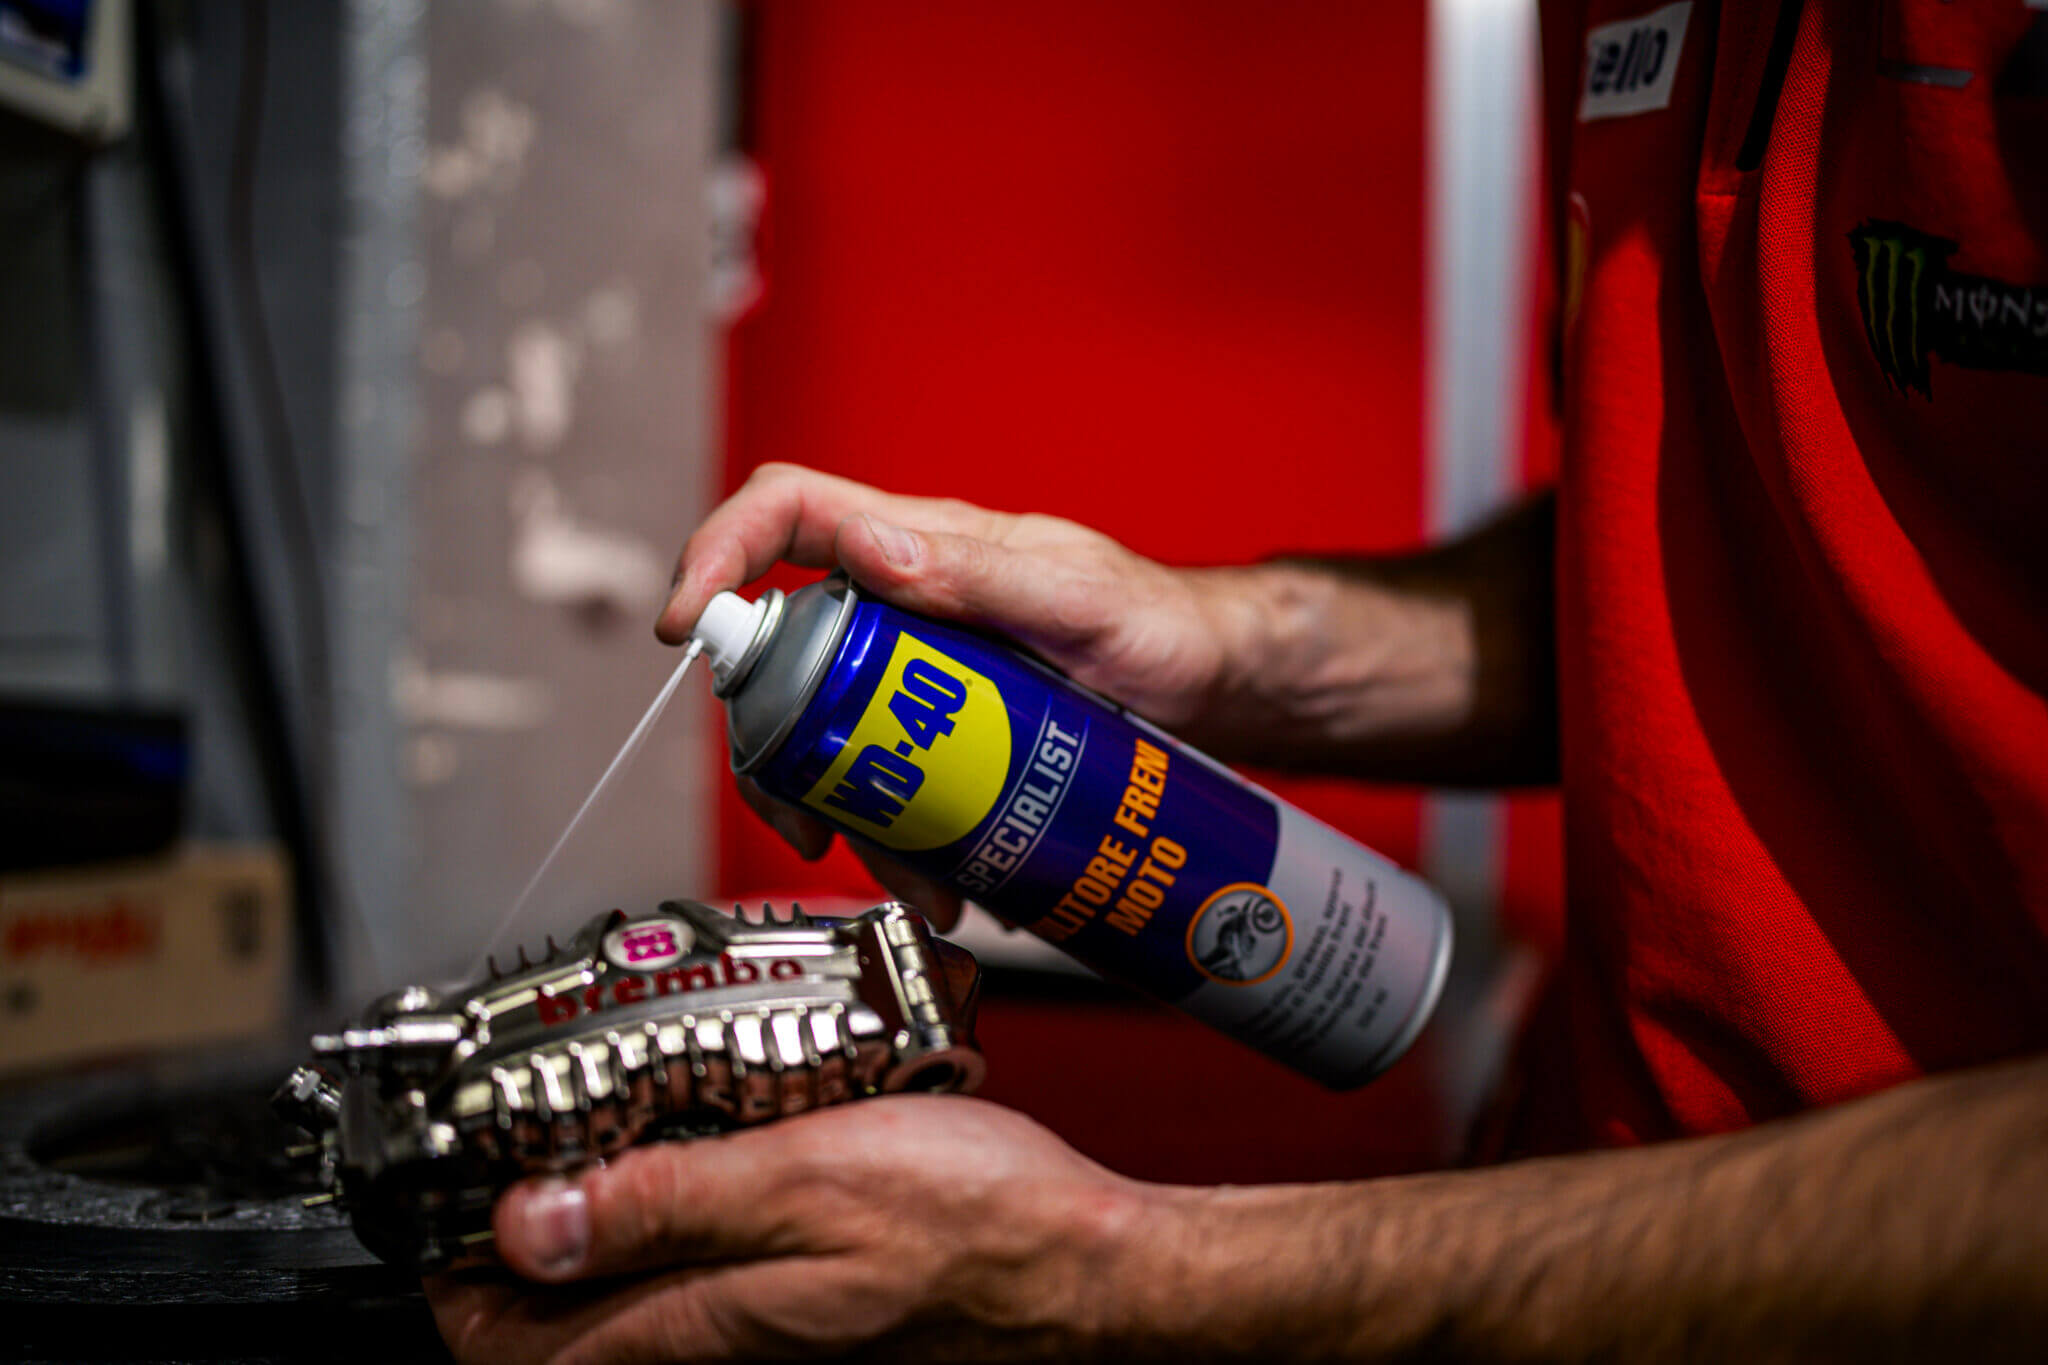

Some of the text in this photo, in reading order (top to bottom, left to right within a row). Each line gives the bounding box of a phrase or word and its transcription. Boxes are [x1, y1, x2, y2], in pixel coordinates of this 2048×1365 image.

[822, 658, 968, 829] WD-40
[957, 720, 1079, 894] SPECIALIST
[1104, 836, 1188, 936] MOTO
[537, 951, 804, 1027] brembo
